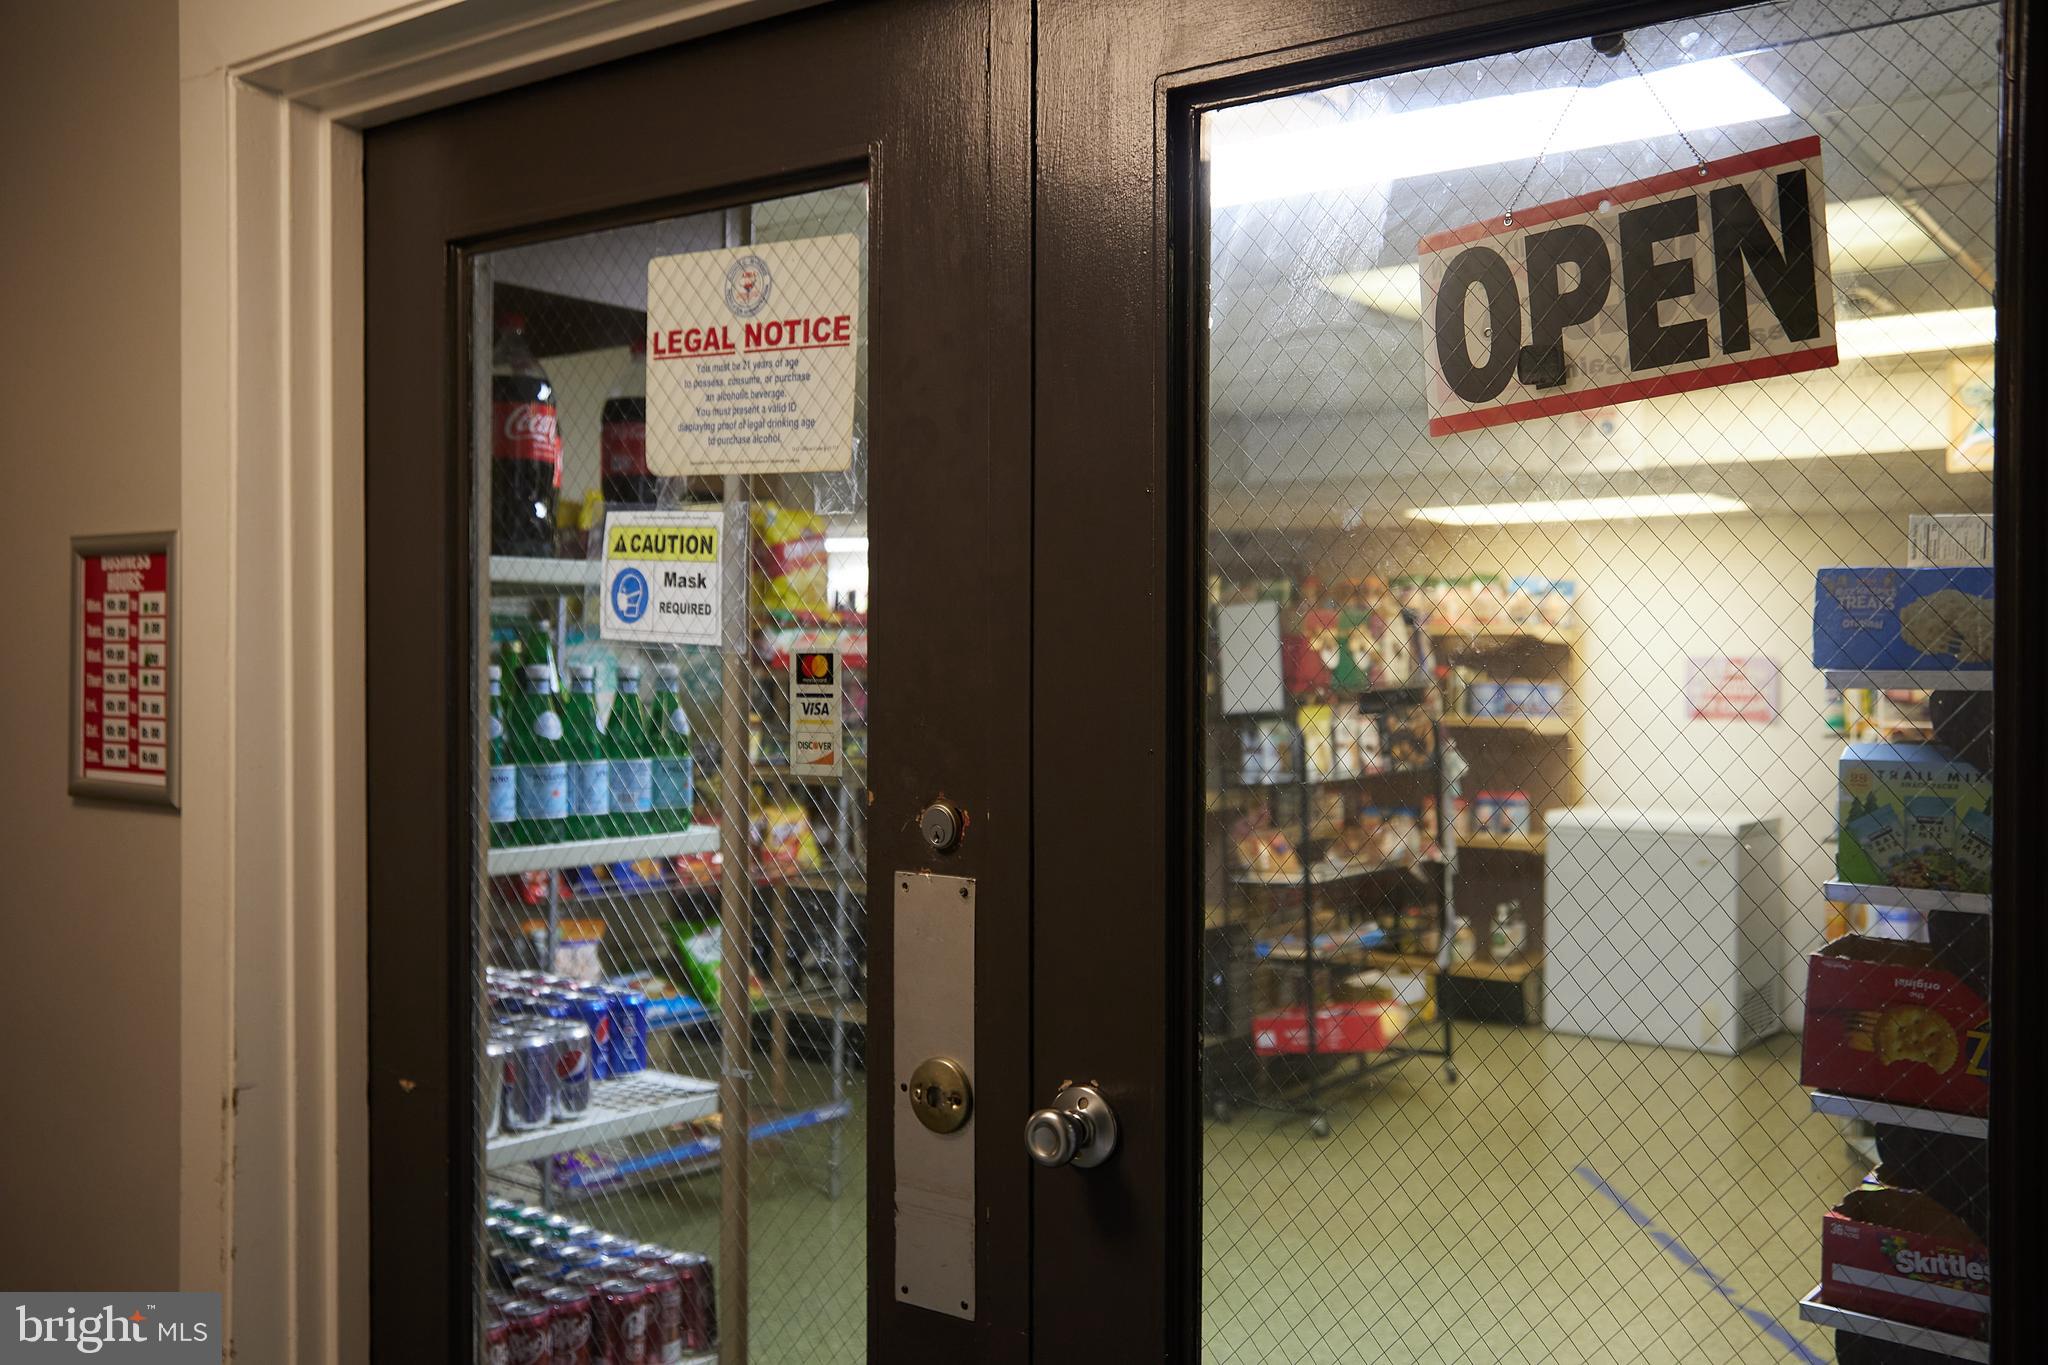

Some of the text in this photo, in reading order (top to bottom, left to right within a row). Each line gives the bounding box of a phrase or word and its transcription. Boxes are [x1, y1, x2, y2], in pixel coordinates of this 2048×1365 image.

[1435, 168, 1820, 403] OPEN
[653, 315, 851, 355] LEGAL NOTICE
[696, 358, 799, 373] You must be 21 years of age
[728, 376, 763, 386] consume,
[765, 375, 772, 384] or
[775, 372, 811, 386] purchase
[705, 389, 787, 402] an alcoholic beverage.
[696, 406, 711, 417] You
[713, 406, 731, 416] must
[732, 405, 759, 417] present
[768, 402, 787, 414] valid
[788, 401, 797, 413] ID
[678, 417, 816, 433] displaying proof of legal drinking age
[708, 436, 715, 446] to
[717, 434, 751, 446] purchase
[630, 534, 714, 554] CAUTION
[664, 572, 707, 589] Mask
[659, 601, 712, 616] REQUIRED
[802, 702, 829, 715] VISA
[798, 741, 832, 751] DISCOVER
[1877, 770, 1932, 781] TRAIL
[1947, 772, 1985, 783] MIX
[1894, 979, 1941, 991] original
